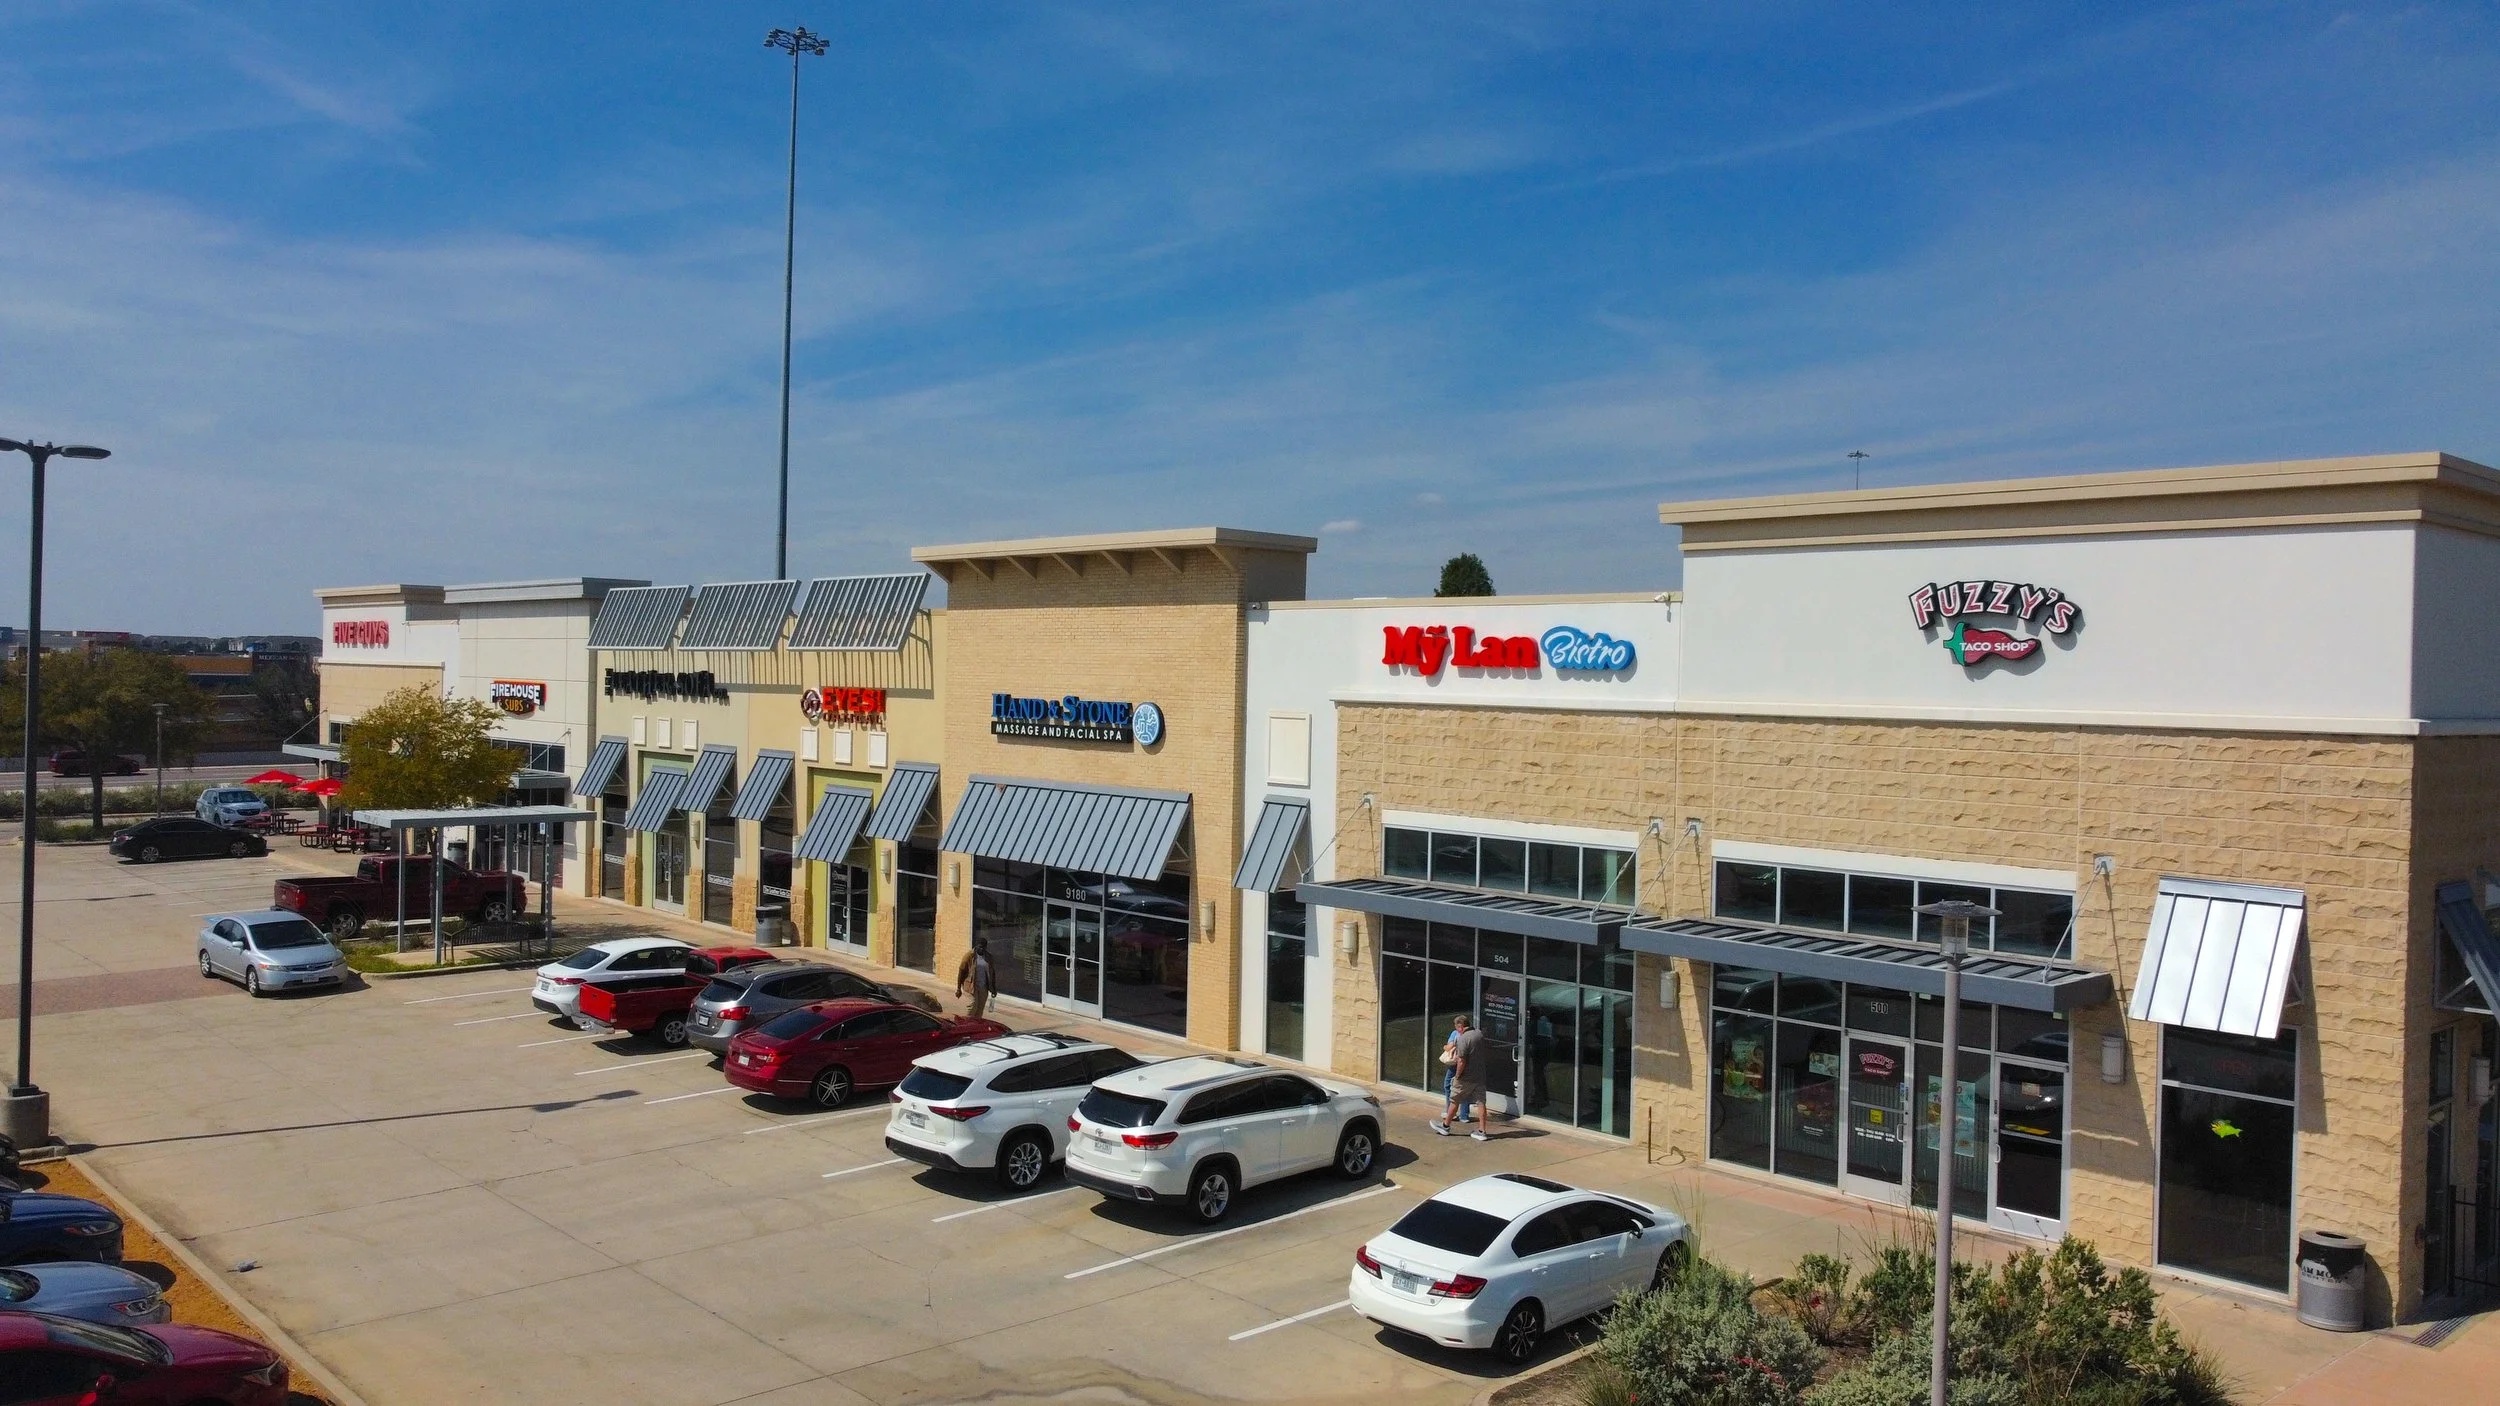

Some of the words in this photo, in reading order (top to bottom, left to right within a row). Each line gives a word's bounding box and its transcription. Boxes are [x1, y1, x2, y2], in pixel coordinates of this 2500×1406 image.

[1909, 582, 2079, 634] FUZZY'S
[333, 622, 357, 644] FIVE
[358, 621, 389, 645] GUYS
[1451, 626, 1540, 668] Lan
[1544, 630, 1628, 666] Bistro
[1959, 642, 1991, 652] TACO
[1995, 642, 2029, 652] SHOP
[490, 684, 541, 705] FIREHOUSE
[822, 688, 886, 713] EYES!
[504, 699, 524, 711] SUBS
[992, 693, 1045, 719] HAND
[1048, 701, 1059, 718] &
[1063, 695, 1128, 725] STONE
[996, 724, 1039, 736] MASSAGE
[1041, 727, 1062, 738] AND
[1064, 728, 1101, 740] FACIAL
[1103, 730, 1122, 740] SPA
[1066, 888, 1086, 901] 9180
[1494, 955, 1509, 964] 504
[1871, 1002, 1888, 1014] 500
